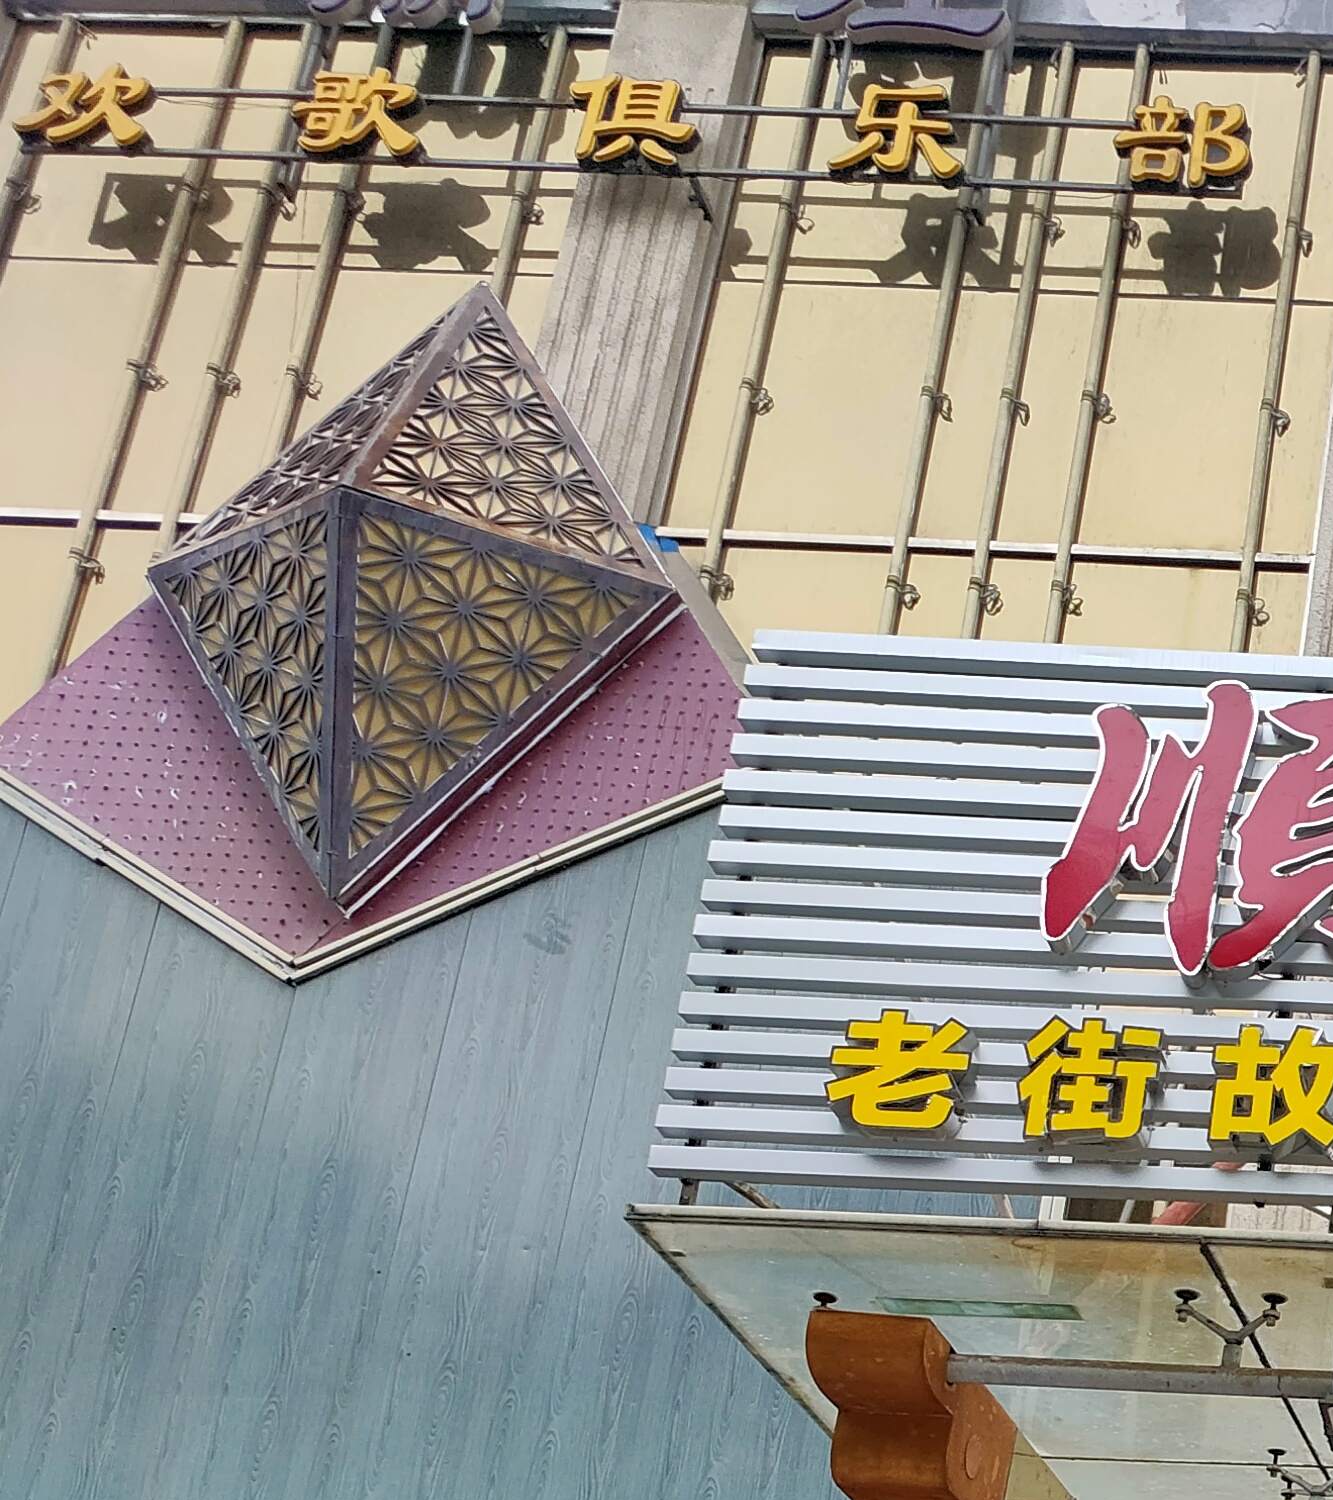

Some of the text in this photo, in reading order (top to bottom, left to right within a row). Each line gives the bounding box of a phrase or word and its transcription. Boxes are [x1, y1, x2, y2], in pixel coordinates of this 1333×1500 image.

[12, 62, 1252, 190] 欢歌俱乐部
